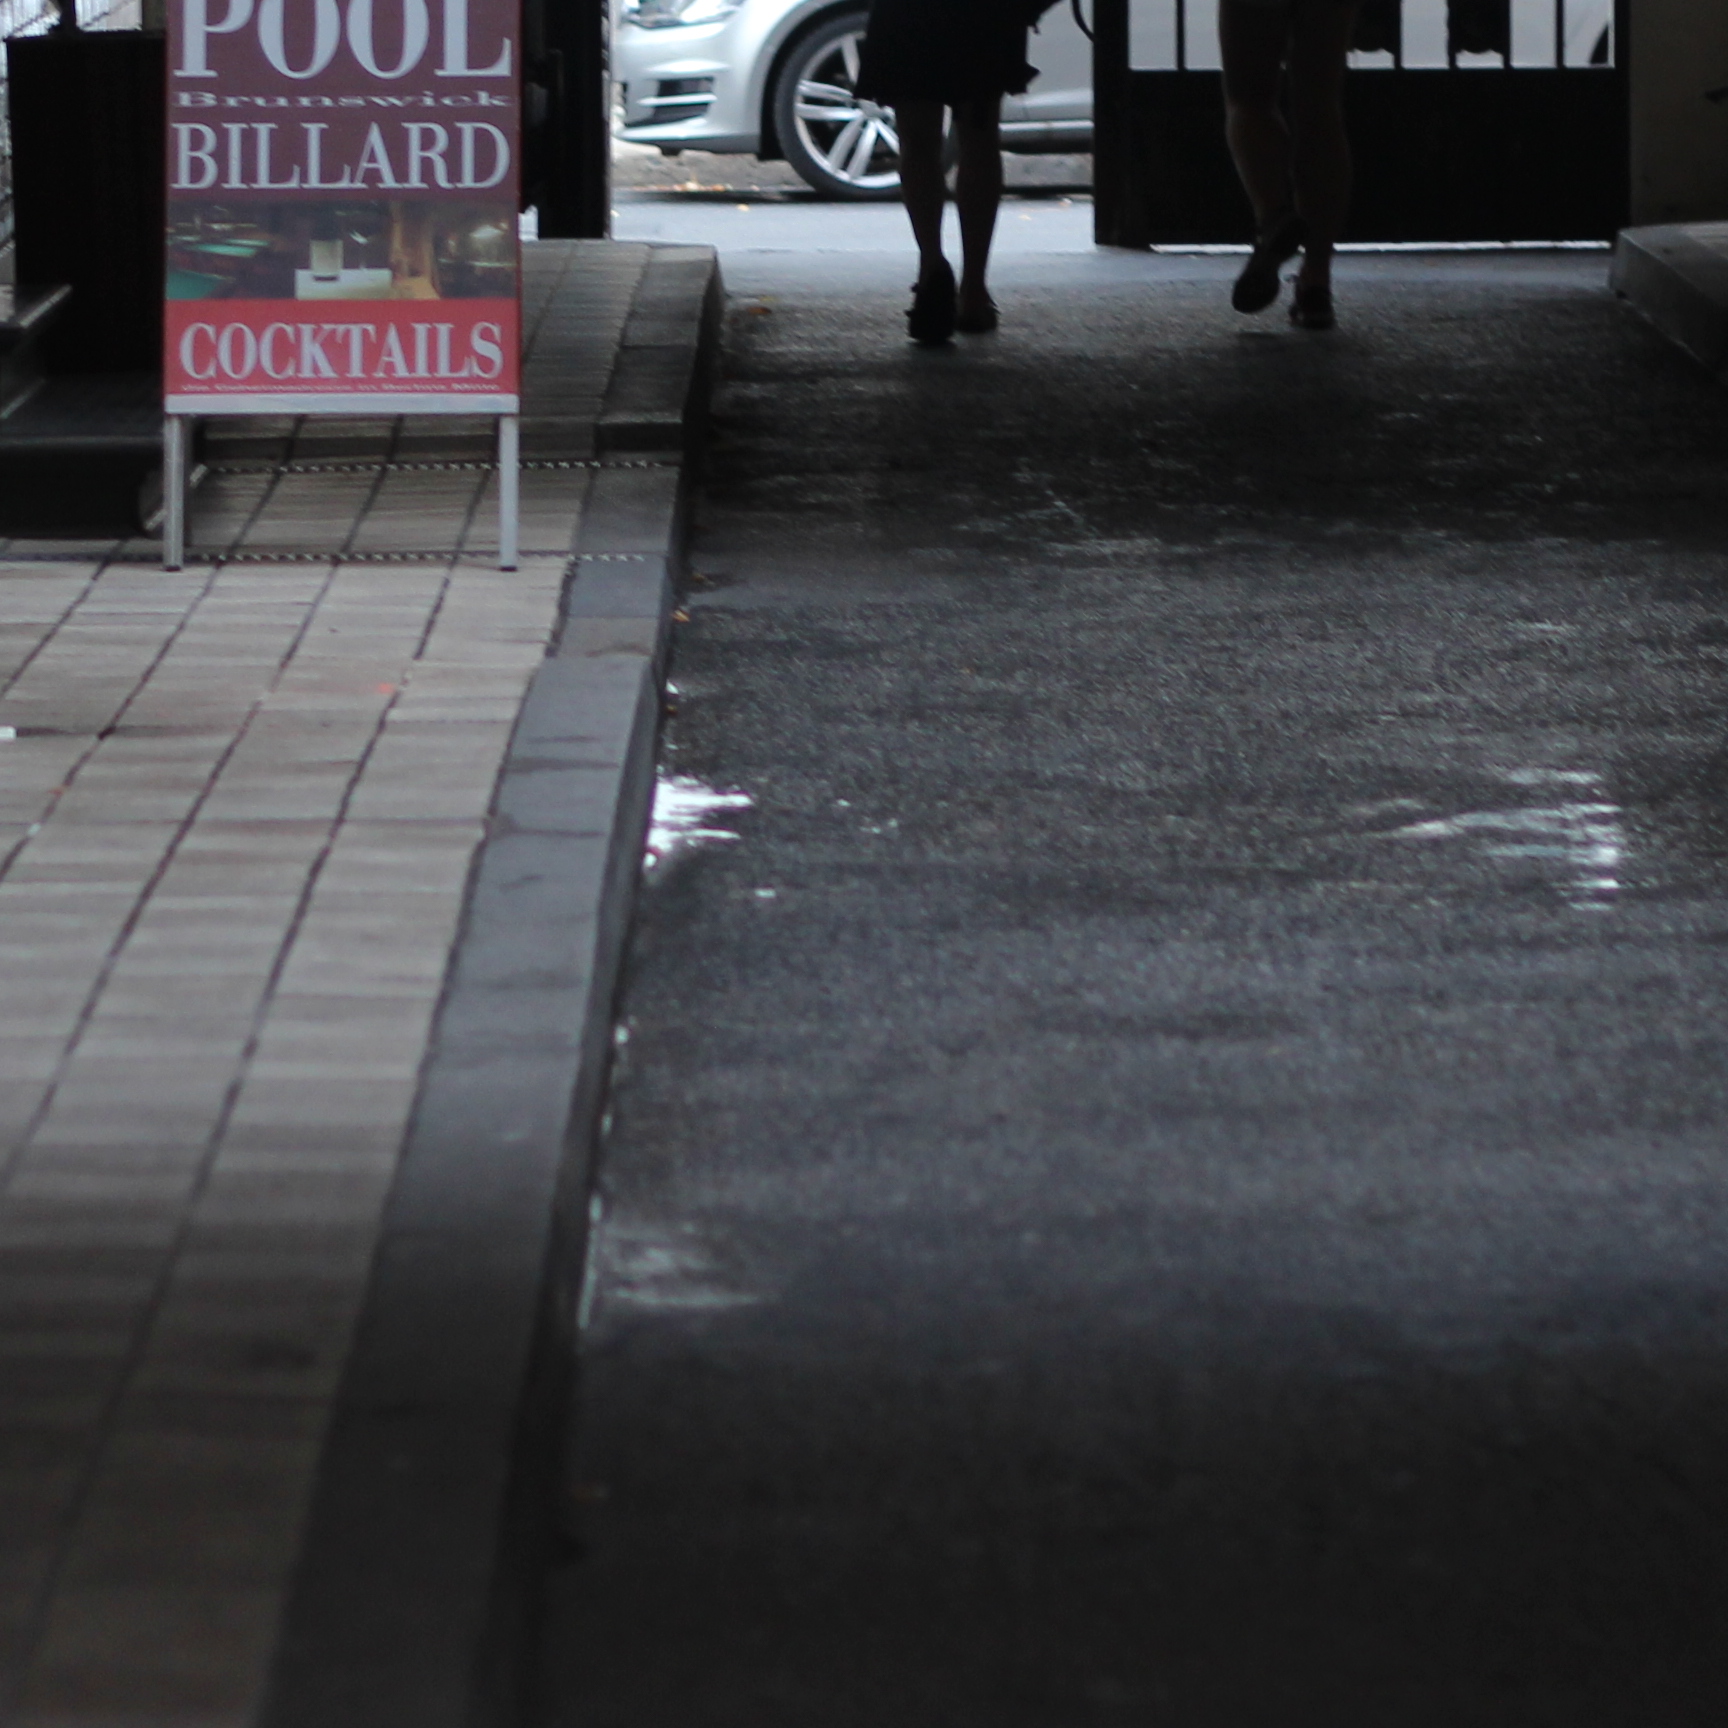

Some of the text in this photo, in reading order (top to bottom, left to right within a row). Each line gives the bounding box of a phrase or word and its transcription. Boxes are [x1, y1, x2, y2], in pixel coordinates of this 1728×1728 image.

[173, 90, 513, 108] Brunswick
[170, 121, 511, 190] BILLARD
[179, 321, 504, 380] COCKTAILS
